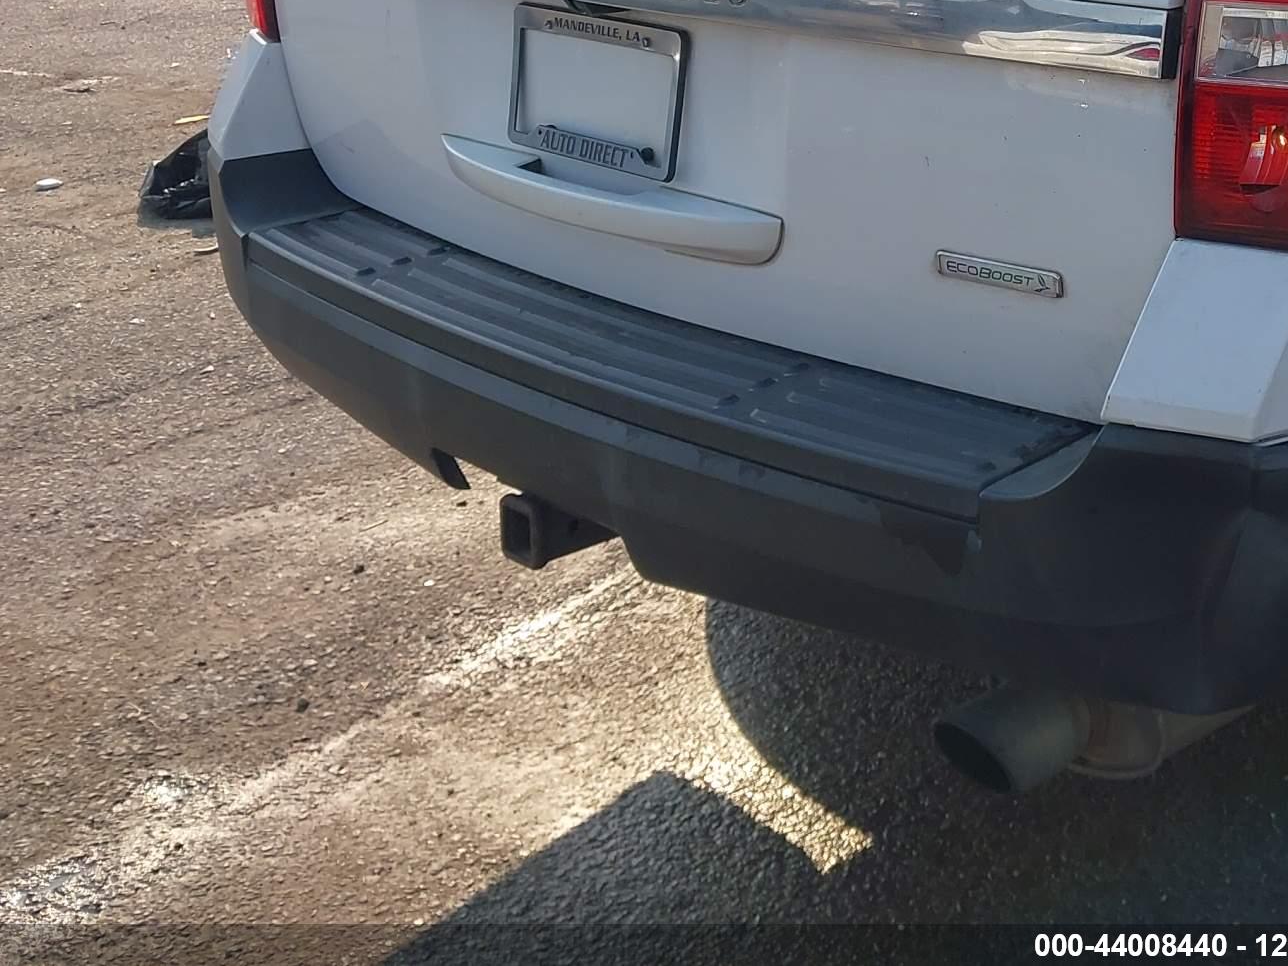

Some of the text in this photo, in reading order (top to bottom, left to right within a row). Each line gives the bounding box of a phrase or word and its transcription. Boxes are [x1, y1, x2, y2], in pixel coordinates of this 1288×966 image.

[554, 17, 640, 42] MANDEVILLE, LA
[540, 130, 628, 167] AUTO DIRECT
